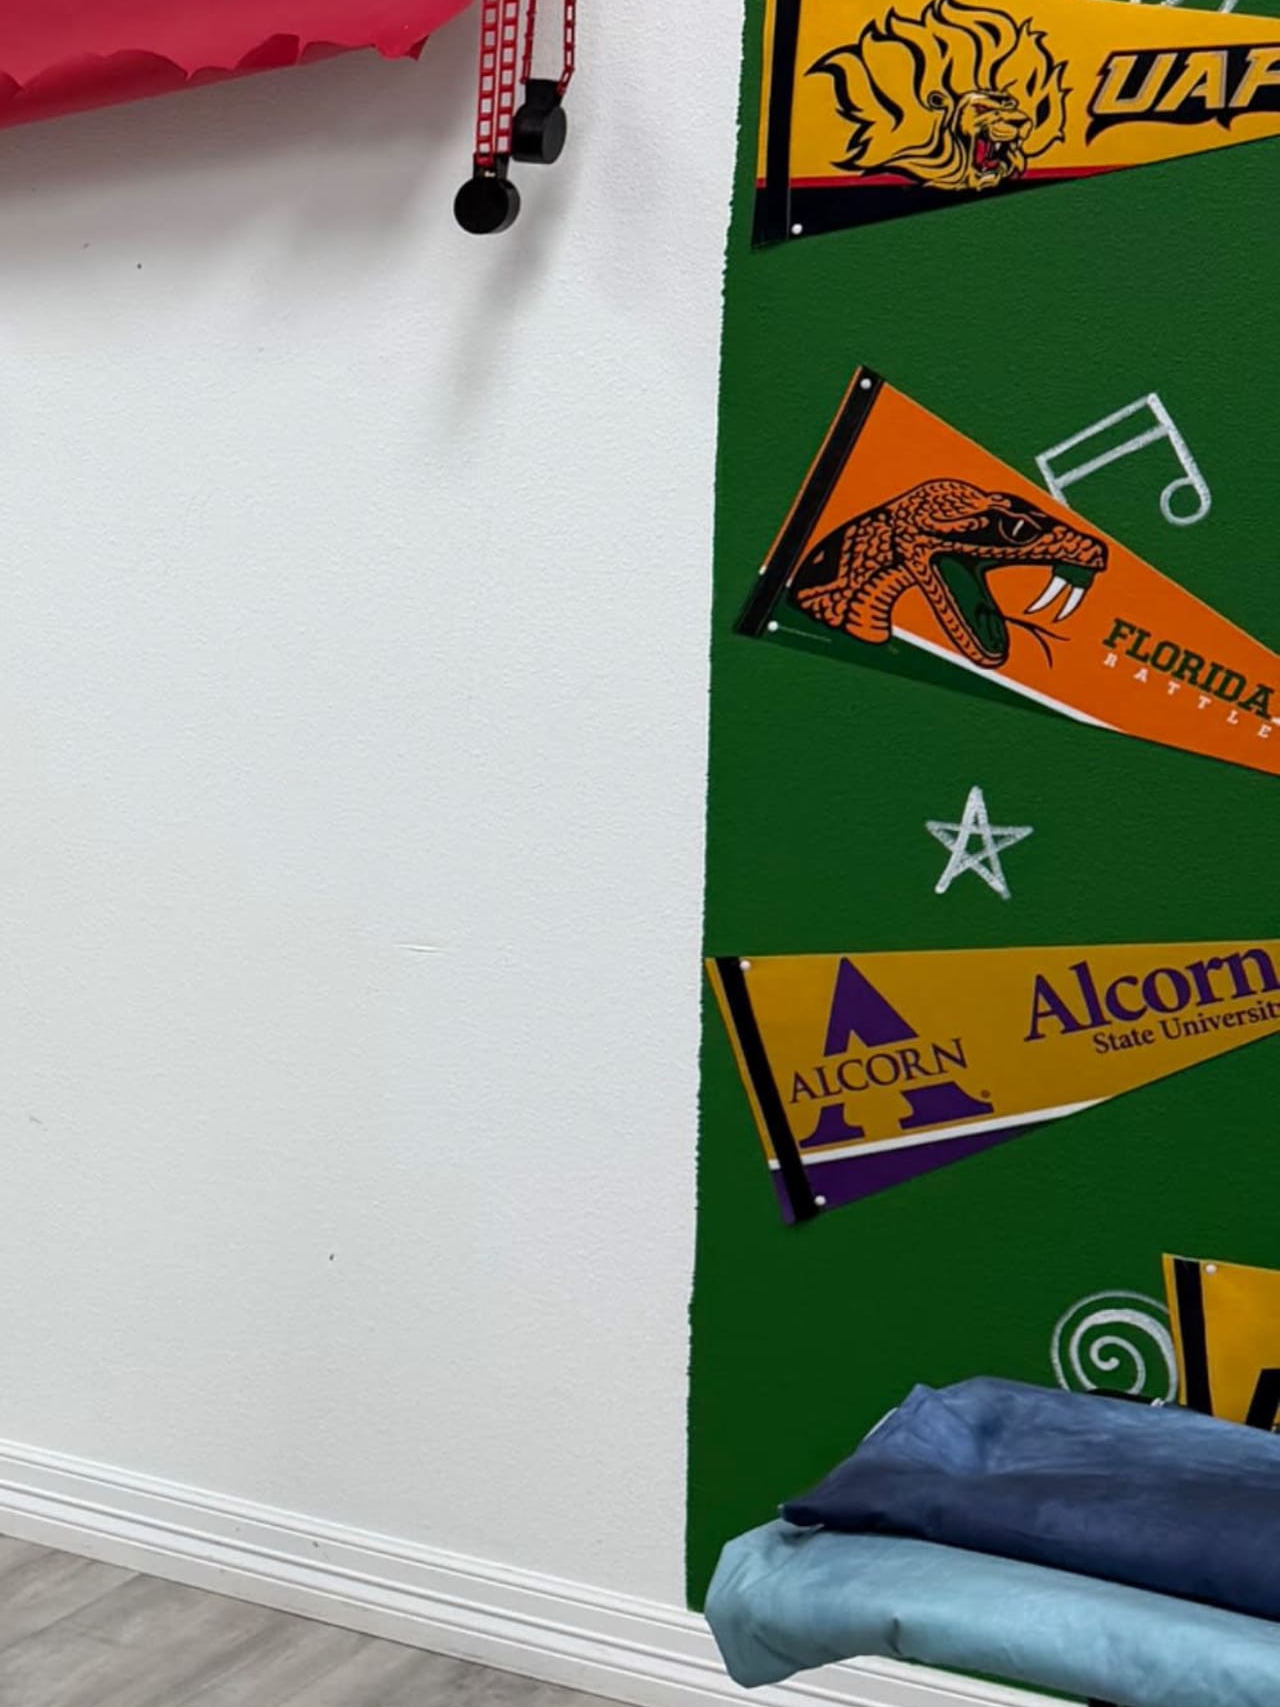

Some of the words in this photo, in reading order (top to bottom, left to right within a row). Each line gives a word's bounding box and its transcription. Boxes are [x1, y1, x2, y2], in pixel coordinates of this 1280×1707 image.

[1102, 618, 1275, 720] FLORIDA
[1023, 947, 1280, 1042] Alcorn
[1093, 1028, 1156, 1054] State
[1159, 1000, 1280, 1040] Universit
[790, 1038, 968, 1103] ALCORN
